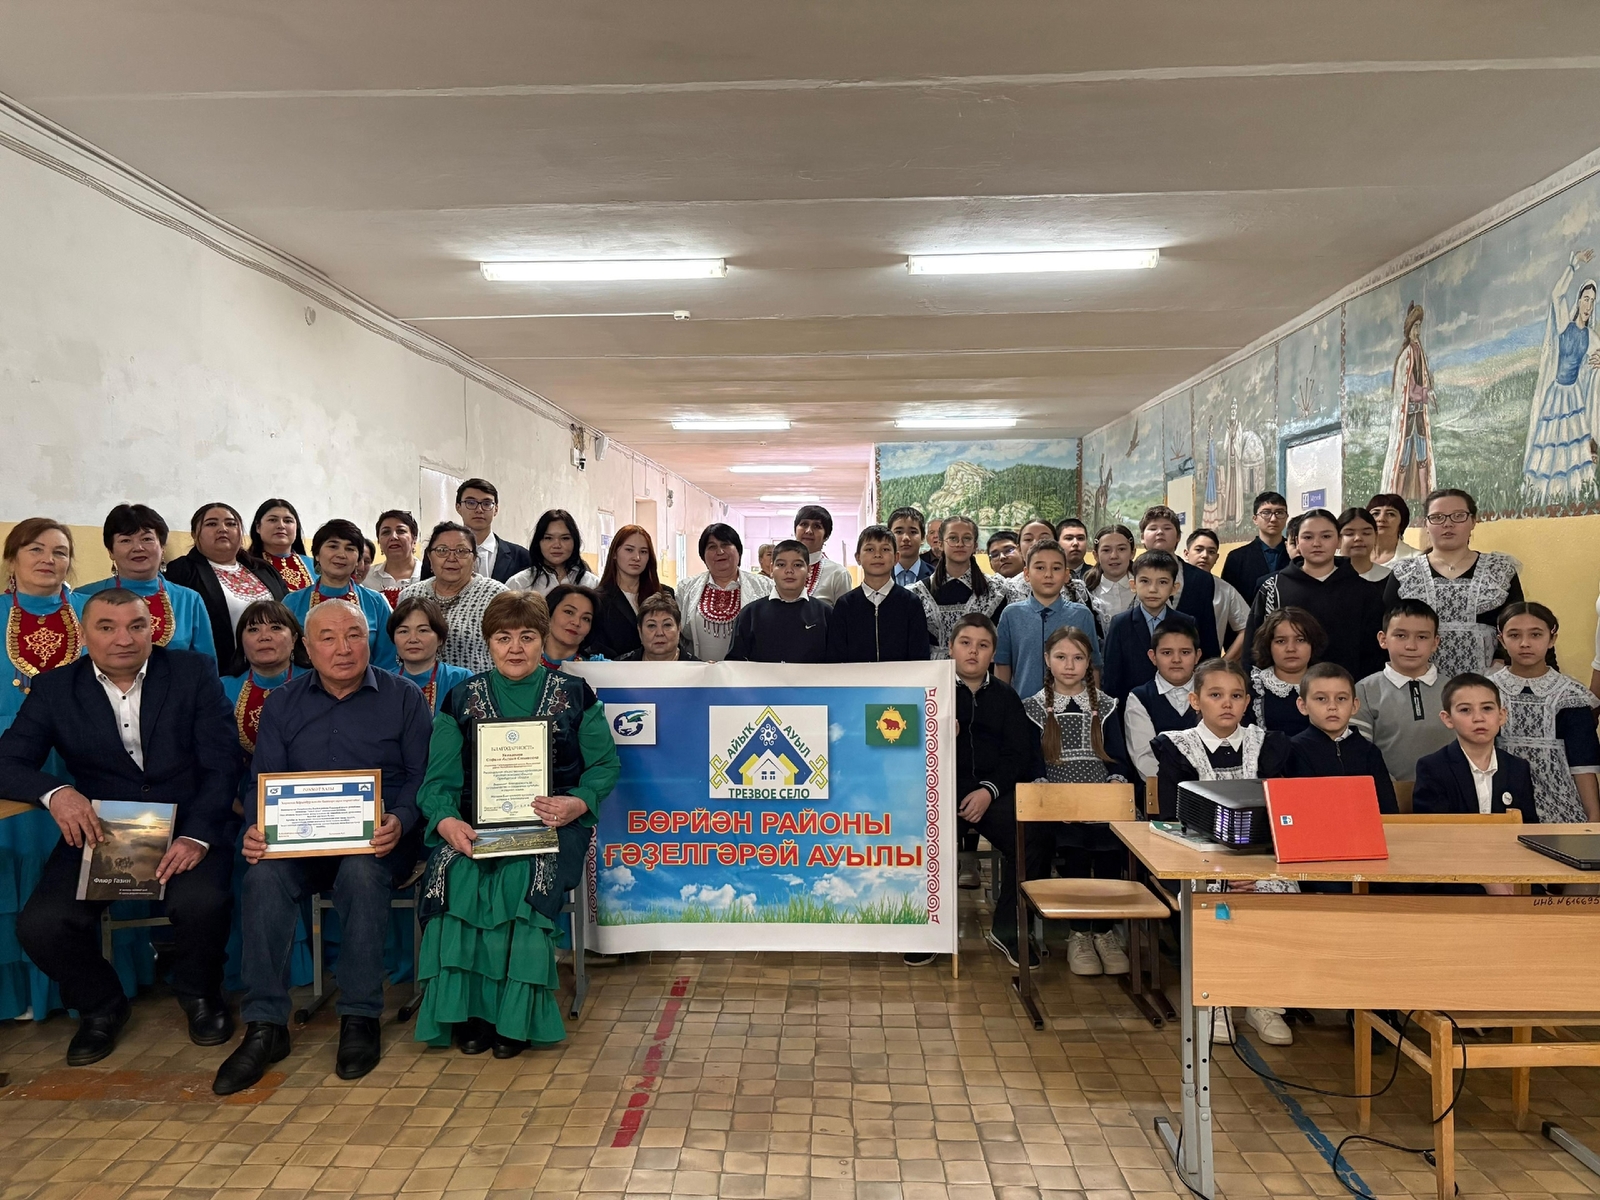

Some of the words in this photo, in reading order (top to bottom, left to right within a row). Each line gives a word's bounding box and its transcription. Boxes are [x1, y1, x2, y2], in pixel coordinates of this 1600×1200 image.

[783, 725, 811, 758] АУЫЛ
[728, 788, 776, 799] ТРЕЗВОЕ
[779, 788, 810, 799] СЕЛО
[627, 807, 752, 834] БӨРЙӘН
[761, 808, 891, 835] РАЙОНЫ
[806, 845, 922, 868] АУЫЛЫ
